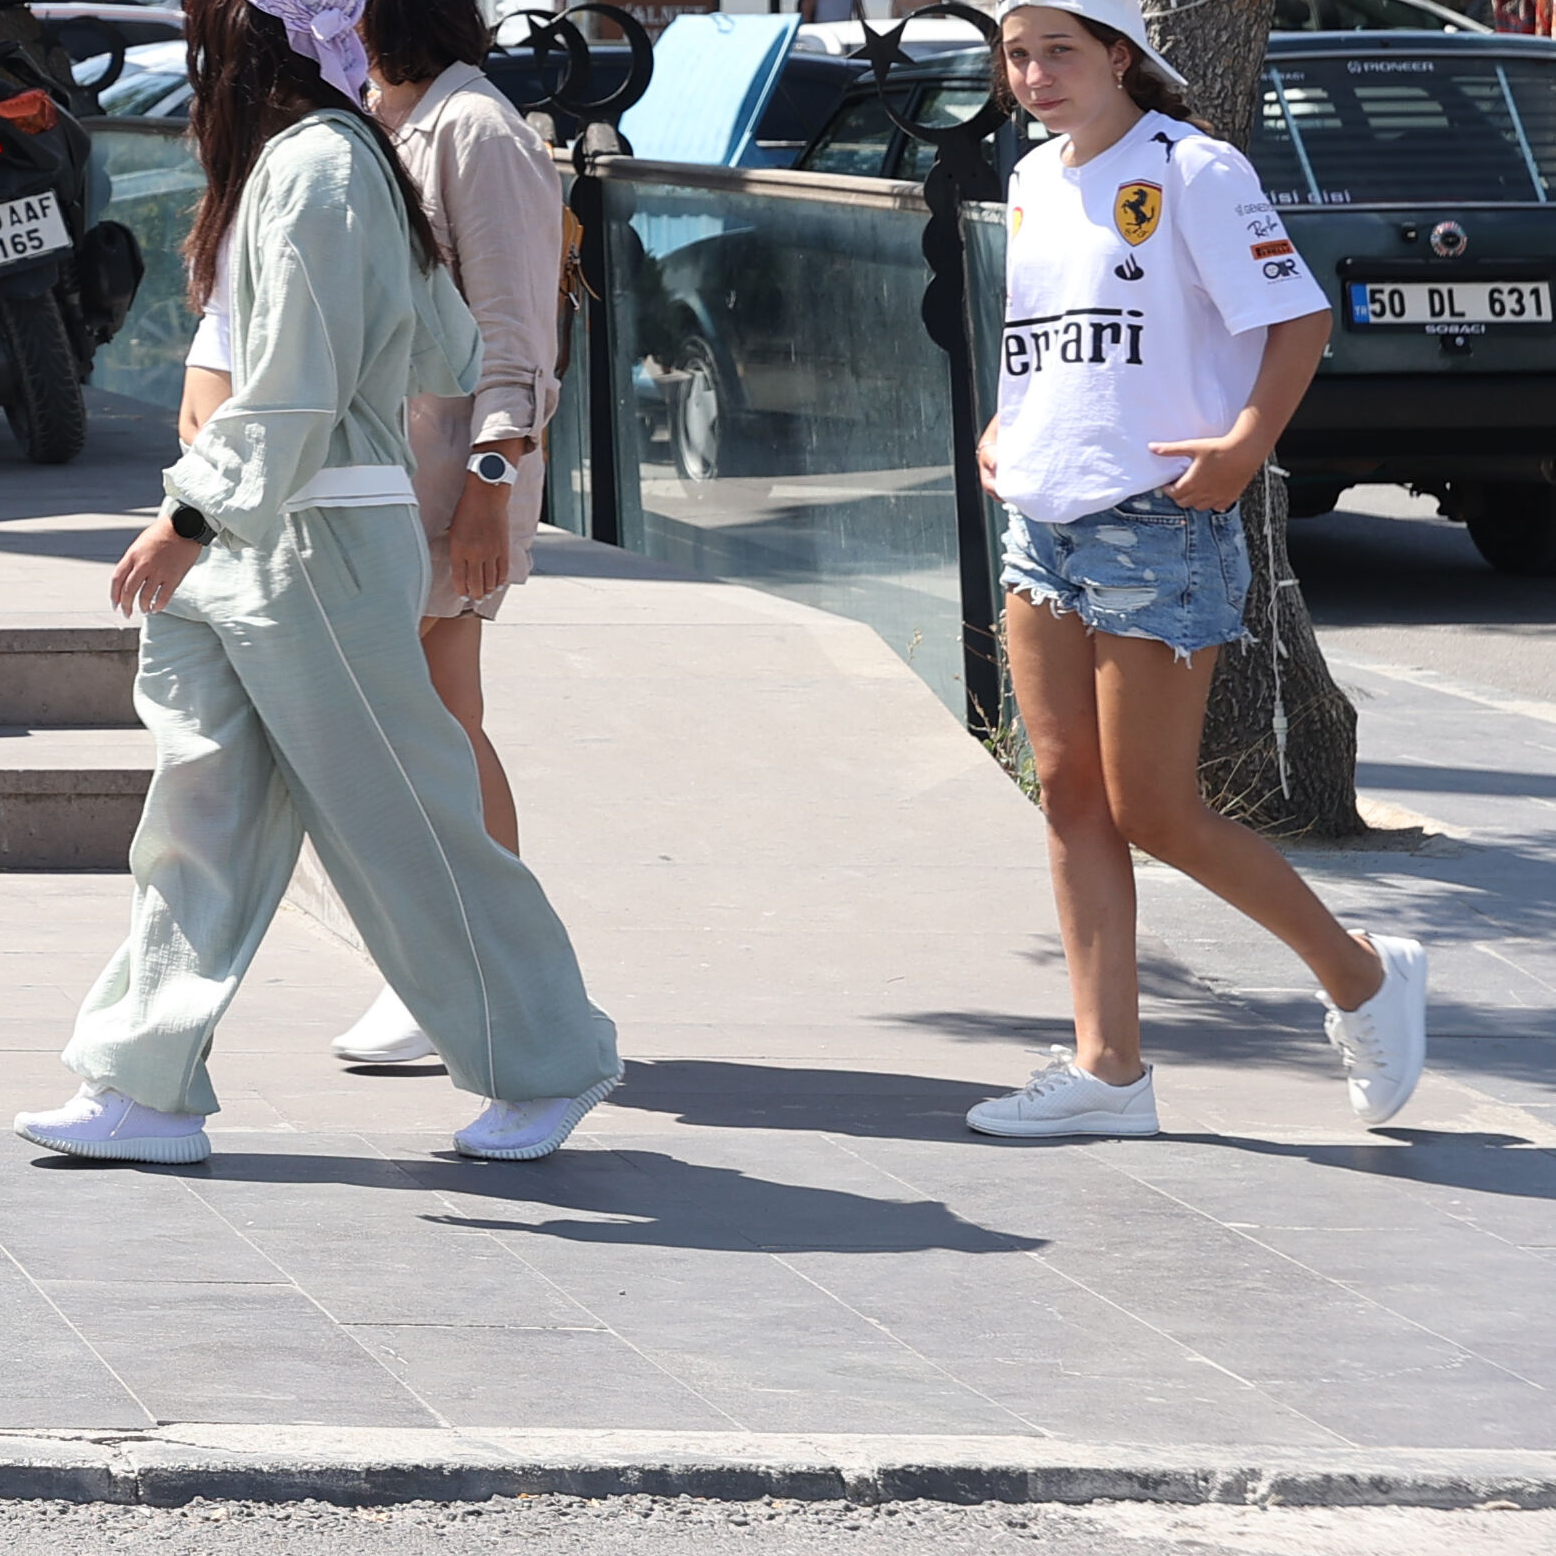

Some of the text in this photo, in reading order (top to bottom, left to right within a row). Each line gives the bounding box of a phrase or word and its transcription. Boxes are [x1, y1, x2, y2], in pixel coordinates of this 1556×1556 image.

[9, 195, 52, 227] AAF
[1355, 286, 1544, 319] TR 50 DL 631
